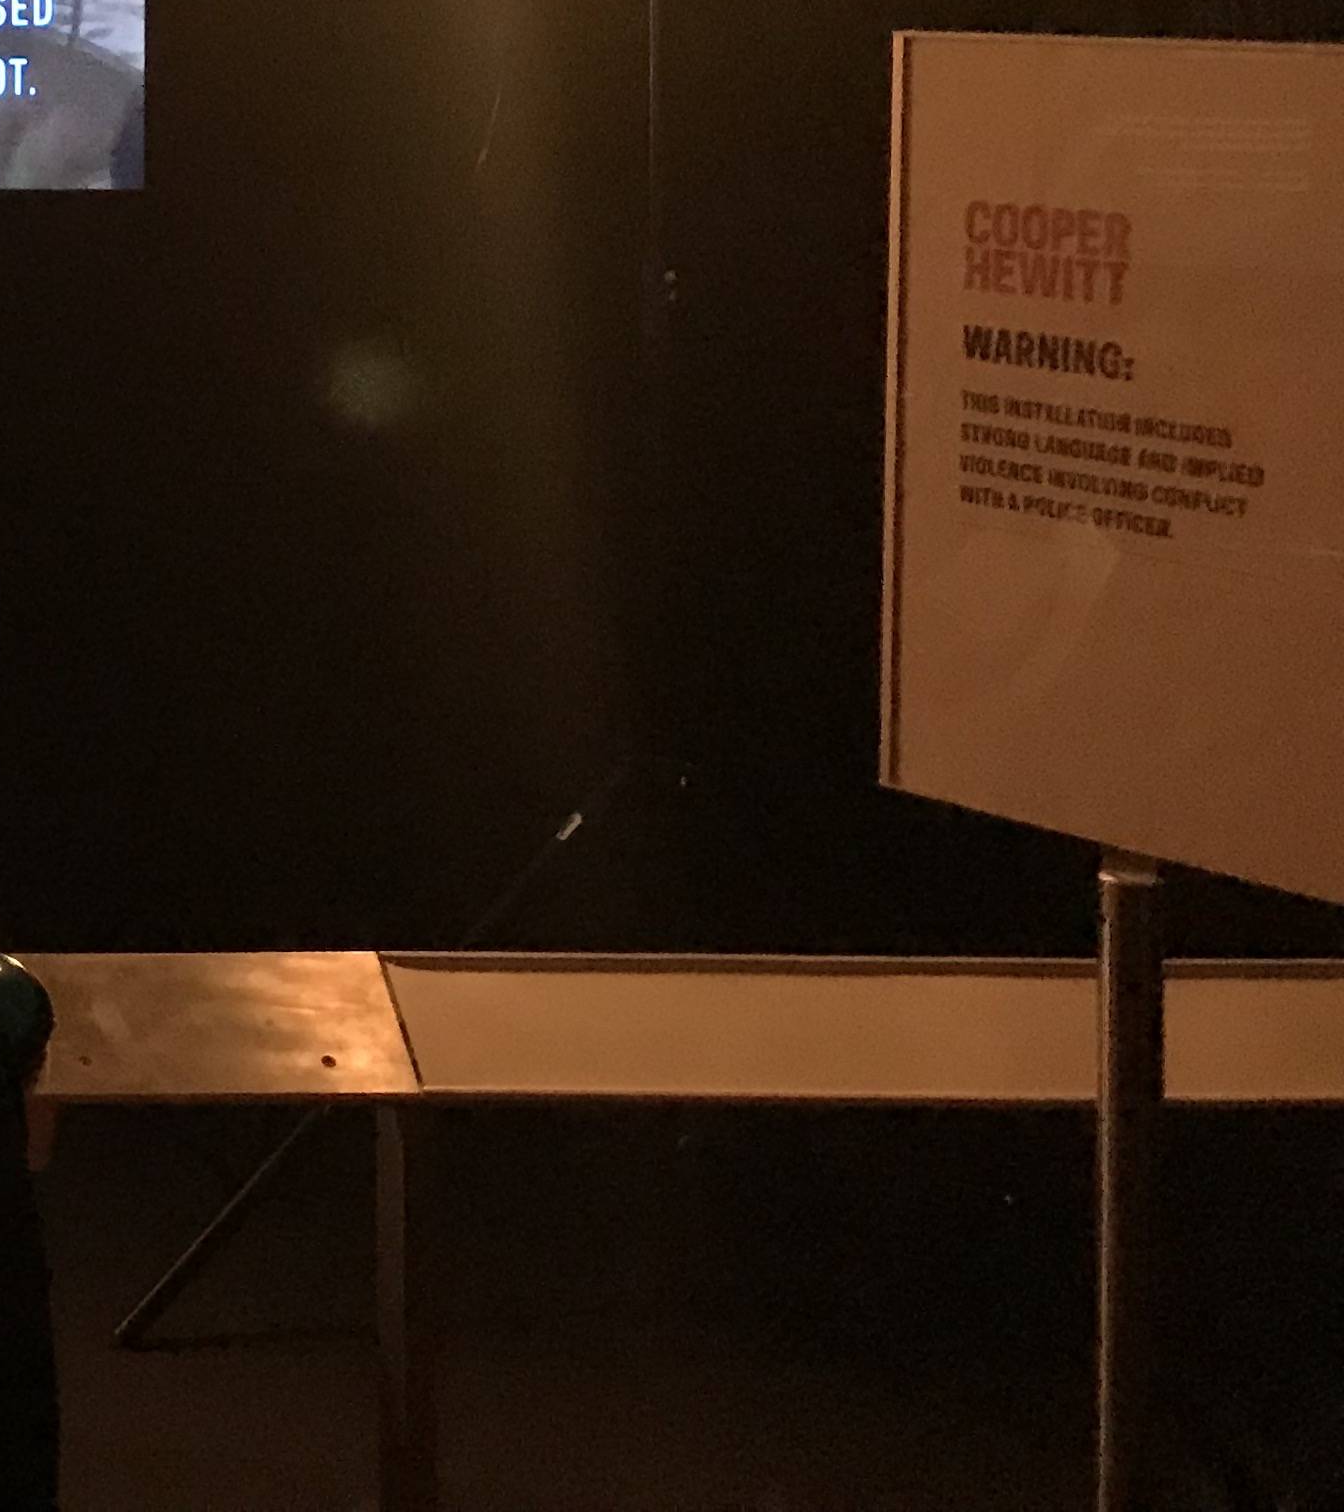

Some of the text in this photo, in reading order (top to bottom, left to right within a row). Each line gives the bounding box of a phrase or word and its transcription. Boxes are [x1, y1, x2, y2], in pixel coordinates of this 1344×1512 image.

[965, 200, 1132, 256] COOPER
[964, 245, 1129, 305] HEWITT
[963, 325, 1136, 381] WARNING:
[962, 389, 1000, 414] THIS
[1004, 395, 1131, 433] INSTALLATION
[960, 423, 1264, 487] STRONG LANGUAGE AND IMPLIED
[959, 454, 1248, 518] VIOLENCE INVOLVING CONFLICT
[960, 484, 1004, 509] WITH
[1008, 495, 1020, 511] A
[1023, 496, 1088, 524] POLICE
